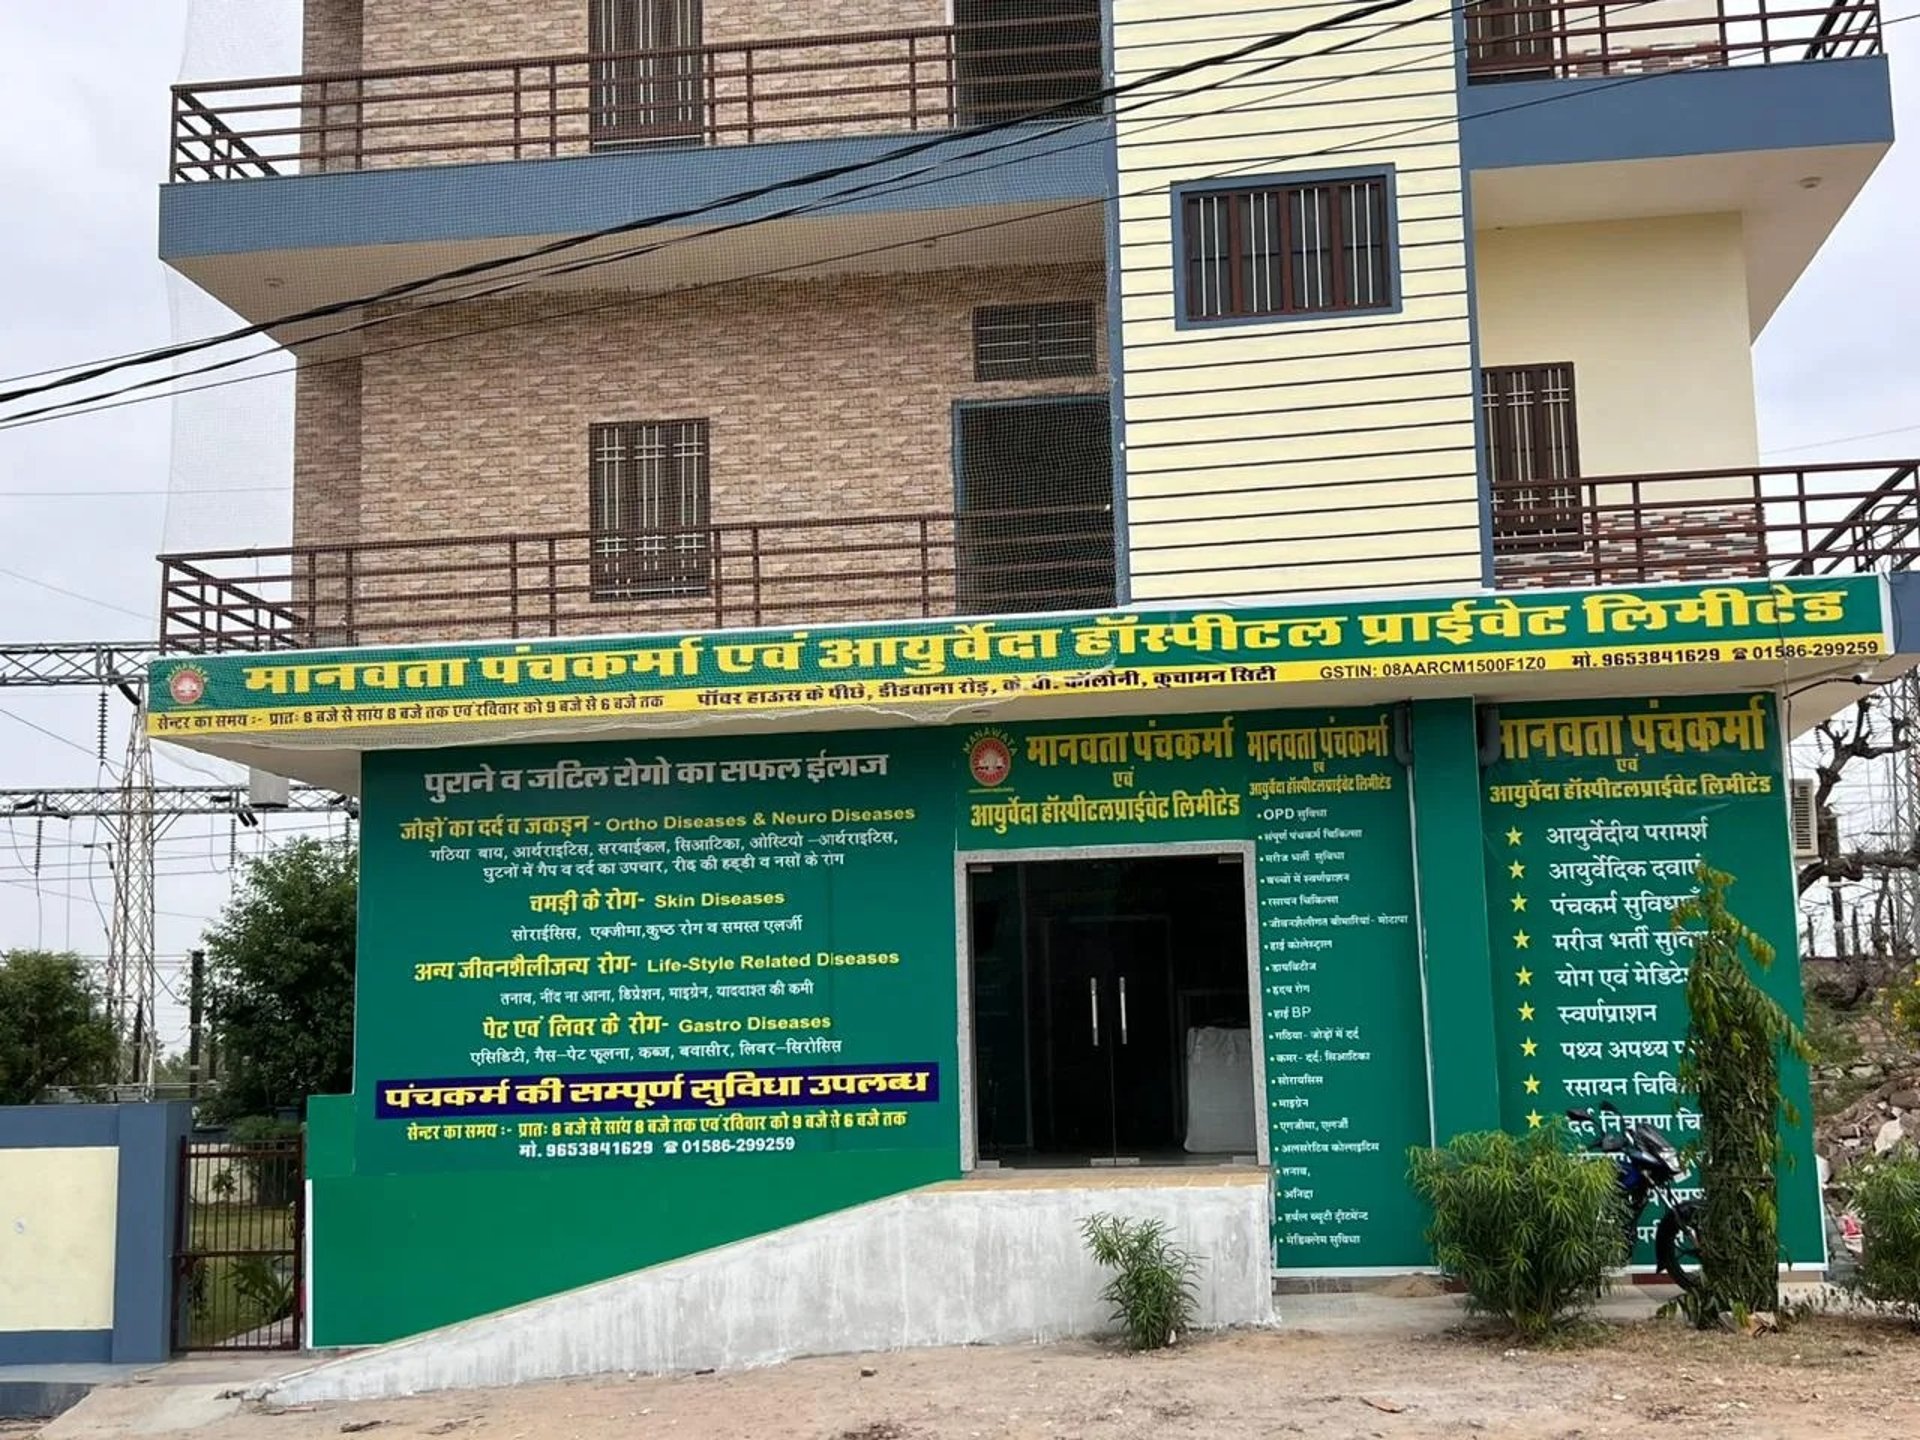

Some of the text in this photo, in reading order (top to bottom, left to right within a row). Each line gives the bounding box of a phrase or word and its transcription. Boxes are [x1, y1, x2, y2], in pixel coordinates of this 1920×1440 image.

[242, 658, 470, 694] मानवता
[478, 637, 703, 684] पंचकर्मा
[714, 632, 808, 673] एवं
[818, 621, 1062, 675] आयुर्वेदा
[1072, 613, 1348, 656] हॉस्पीटल
[1358, 599, 1570, 645] प्राईवेट
[1582, 584, 1848, 633] लिमीटेड
[1320, 665, 1377, 679] GSTIN:
[1602, 648, 1720, 666] 9653841629
[1753, 640, 1879, 660] 01586-299259
[805, 683, 824, 702] के
[1154, 667, 1226, 689] कुचामन
[1232, 664, 1277, 684] सिटी
[1246, 714, 1389, 763] मानवता पंचकर्मा
[1629, 695, 1765, 754] पंचकर्मा
[1026, 716, 1234, 767] मानवता पंचकर्मा
[424, 763, 495, 804] पुराने
[501, 769, 523, 791] व
[528, 760, 609, 789] जटिल
[676, 761, 717, 784] का
[720, 758, 803, 782] सफल
[806, 749, 889, 784] ईलाज
[1112, 765, 1135, 788] एवं
[1700, 771, 1772, 796] लिमीटेड
[1172, 787, 1240, 819] लिमीटेड
[1263, 808, 1295, 821] OPD
[450, 819, 473, 838] का
[478, 814, 504, 838] दर्द
[508, 820, 520, 836] व
[605, 817, 658, 832] Ortho
[664, 814, 747, 829] Diseases
[753, 811, 767, 826] &
[772, 810, 828, 825] Neuro
[832, 806, 916, 823] Diseases
[1546, 816, 1709, 851] आयुर्वेदीय परामर्श
[1549, 854, 1647, 886] आयुर्वेदिक
[582, 888, 600, 911] के
[654, 894, 695, 908] Skin
[701, 891, 785, 907] Diseases
[1550, 889, 1618, 915] पंचकर्म
[1552, 924, 1651, 952] मरीज भर्ती
[414, 962, 454, 982] अन्य
[458, 953, 590, 980] जीवनशैलीजन्य
[647, 956, 735, 974] Life-Style
[741, 953, 811, 969] Related
[816, 951, 900, 967] Diseases
[1555, 963, 1629, 992] योग एवं
[482, 1015, 509, 1038] पेट
[513, 1015, 545, 1038] एवं
[549, 1014, 597, 1038] लिवर
[601, 1012, 621, 1035] के
[679, 1018, 741, 1033] Gastro
[747, 1015, 831, 1031] Diseases
[1291, 1006, 1312, 1018] BP
[1557, 998, 1657, 1025] स्वर्णप्राशन
[1560, 1041, 1603, 1060] पथ्य
[1608, 1040, 1669, 1060] अपथ्य
[385, 1070, 930, 1109] पंचकर्म की सम्पूर्ण सुविधा उपलब्ध
[1563, 1077, 1628, 1097] रसायन
[444, 1123, 462, 1140] का
[564, 1117, 586, 1135] बजे
[589, 1116, 601, 1135] से
[648, 1115, 670, 1134] बजे
[673, 1117, 696, 1132] तक
[722, 1111, 766, 1131] रविवार
[770, 1110, 789, 1130] को
[805, 1109, 828, 1128] बजे
[857, 1108, 879, 1127] बजे
[882, 1110, 907, 1127] तक
[546, 1140, 653, 1157] 9653841629
[682, 1137, 795, 1154] 01586-299259
